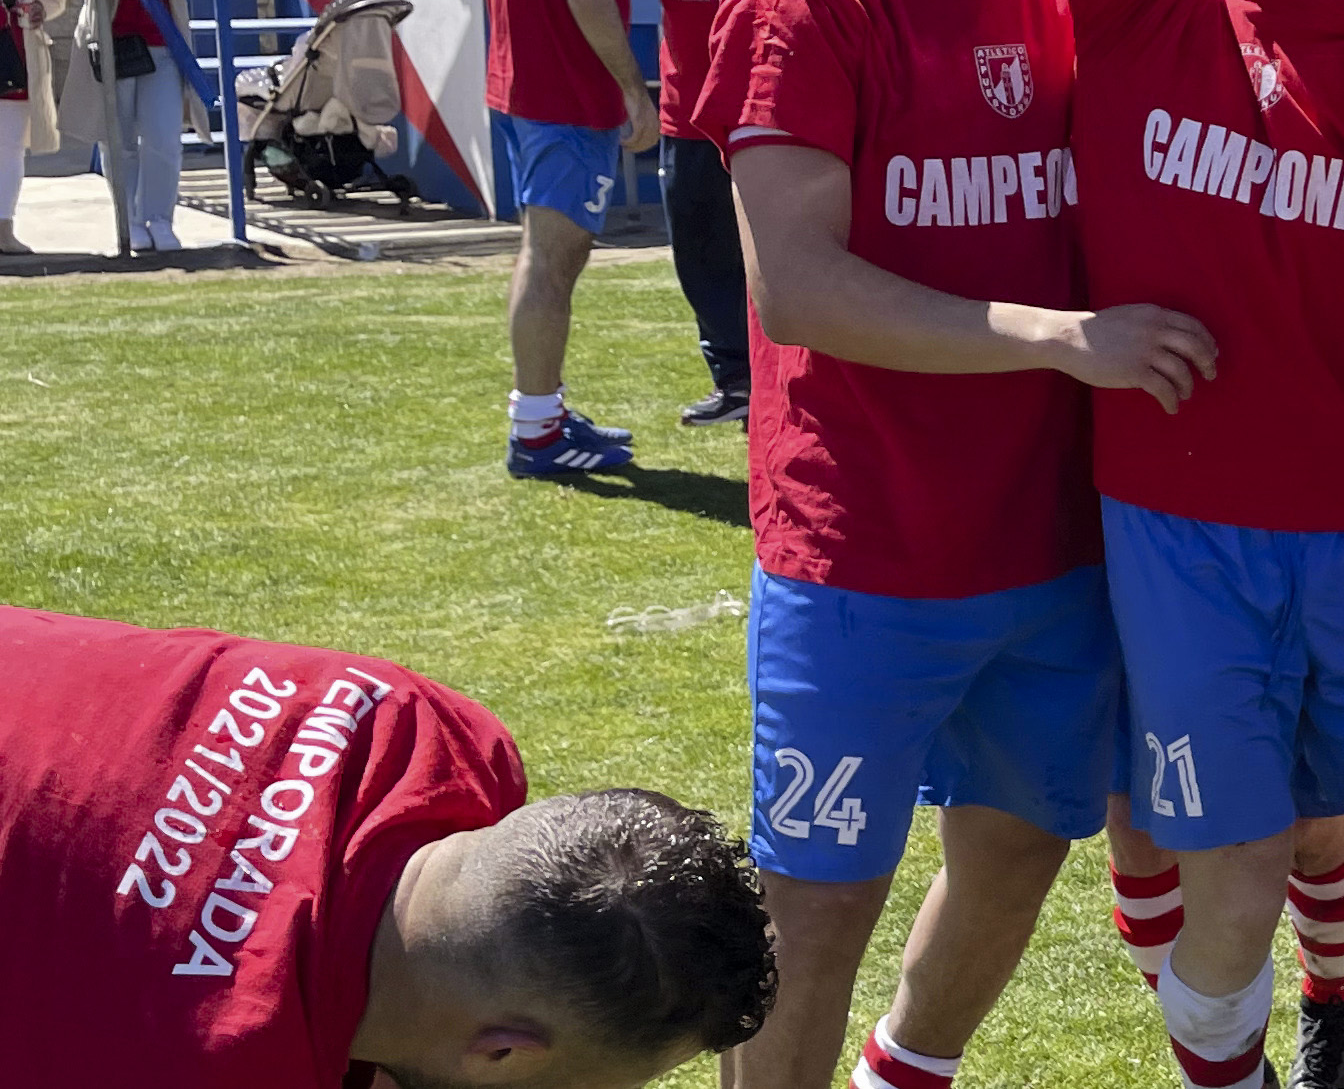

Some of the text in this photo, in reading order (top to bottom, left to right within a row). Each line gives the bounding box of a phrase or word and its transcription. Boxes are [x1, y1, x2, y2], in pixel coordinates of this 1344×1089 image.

[116, 667, 297, 908] 2021/2022
[171, 667, 395, 976] TEMPORADA
[770, 747, 867, 846] 24
